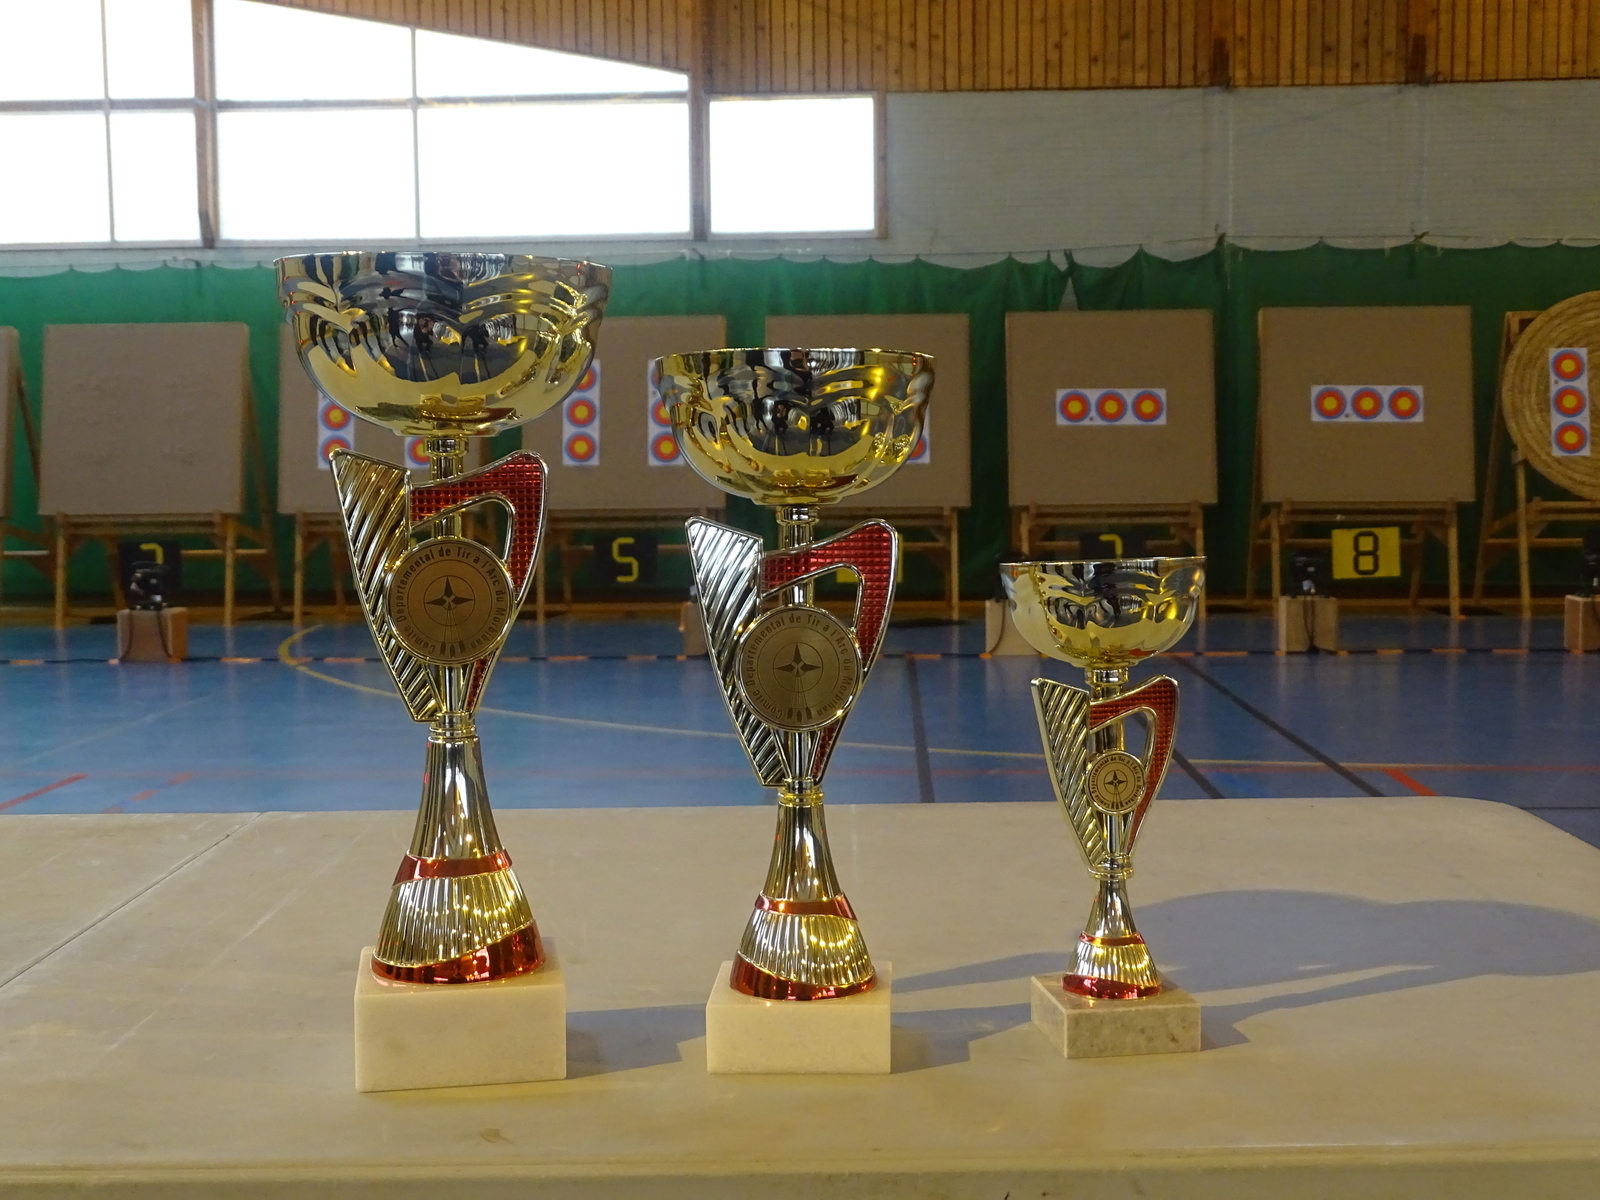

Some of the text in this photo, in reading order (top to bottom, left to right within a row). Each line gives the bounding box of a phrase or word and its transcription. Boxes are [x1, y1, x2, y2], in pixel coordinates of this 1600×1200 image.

[438, 546, 451, 557] de
[456, 546, 471, 559] Tir
[1353, 530, 1379, 576] 8
[612, 536, 639, 582] 5
[495, 590, 506, 602] du
[789, 613, 802, 624] de
[807, 613, 820, 627] Tir
[470, 607, 506, 647] Morbihan
[843, 658, 854, 671] du
[816, 675, 853, 715] Morbihan
